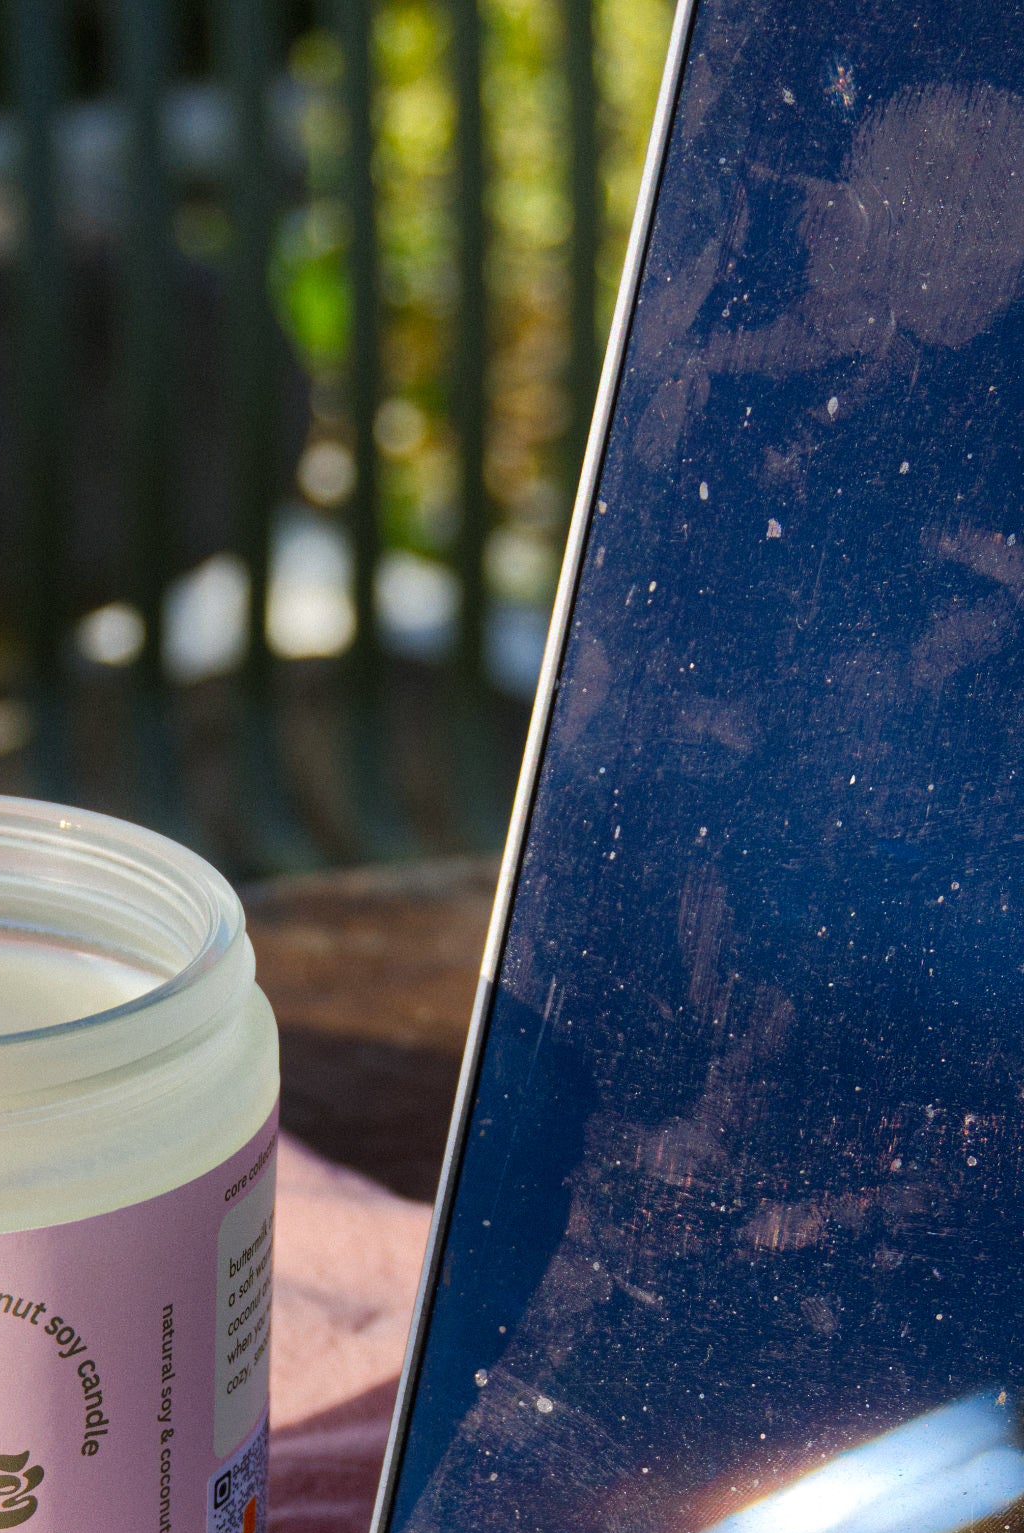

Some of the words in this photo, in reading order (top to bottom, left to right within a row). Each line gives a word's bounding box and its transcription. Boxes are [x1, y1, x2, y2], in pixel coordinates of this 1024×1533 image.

[224, 1175, 248, 1202] core
[228, 1292, 236, 1308] a
[239, 1265, 254, 1298] soft
[227, 1286, 261, 1337] coconut
[161, 1303, 176, 1384] natural
[227, 1337, 252, 1365] when
[44, 1316, 87, 1359] soy
[77, 1359, 110, 1457] candle
[158, 1388, 174, 1423] soy
[160, 1428, 174, 1445] &
